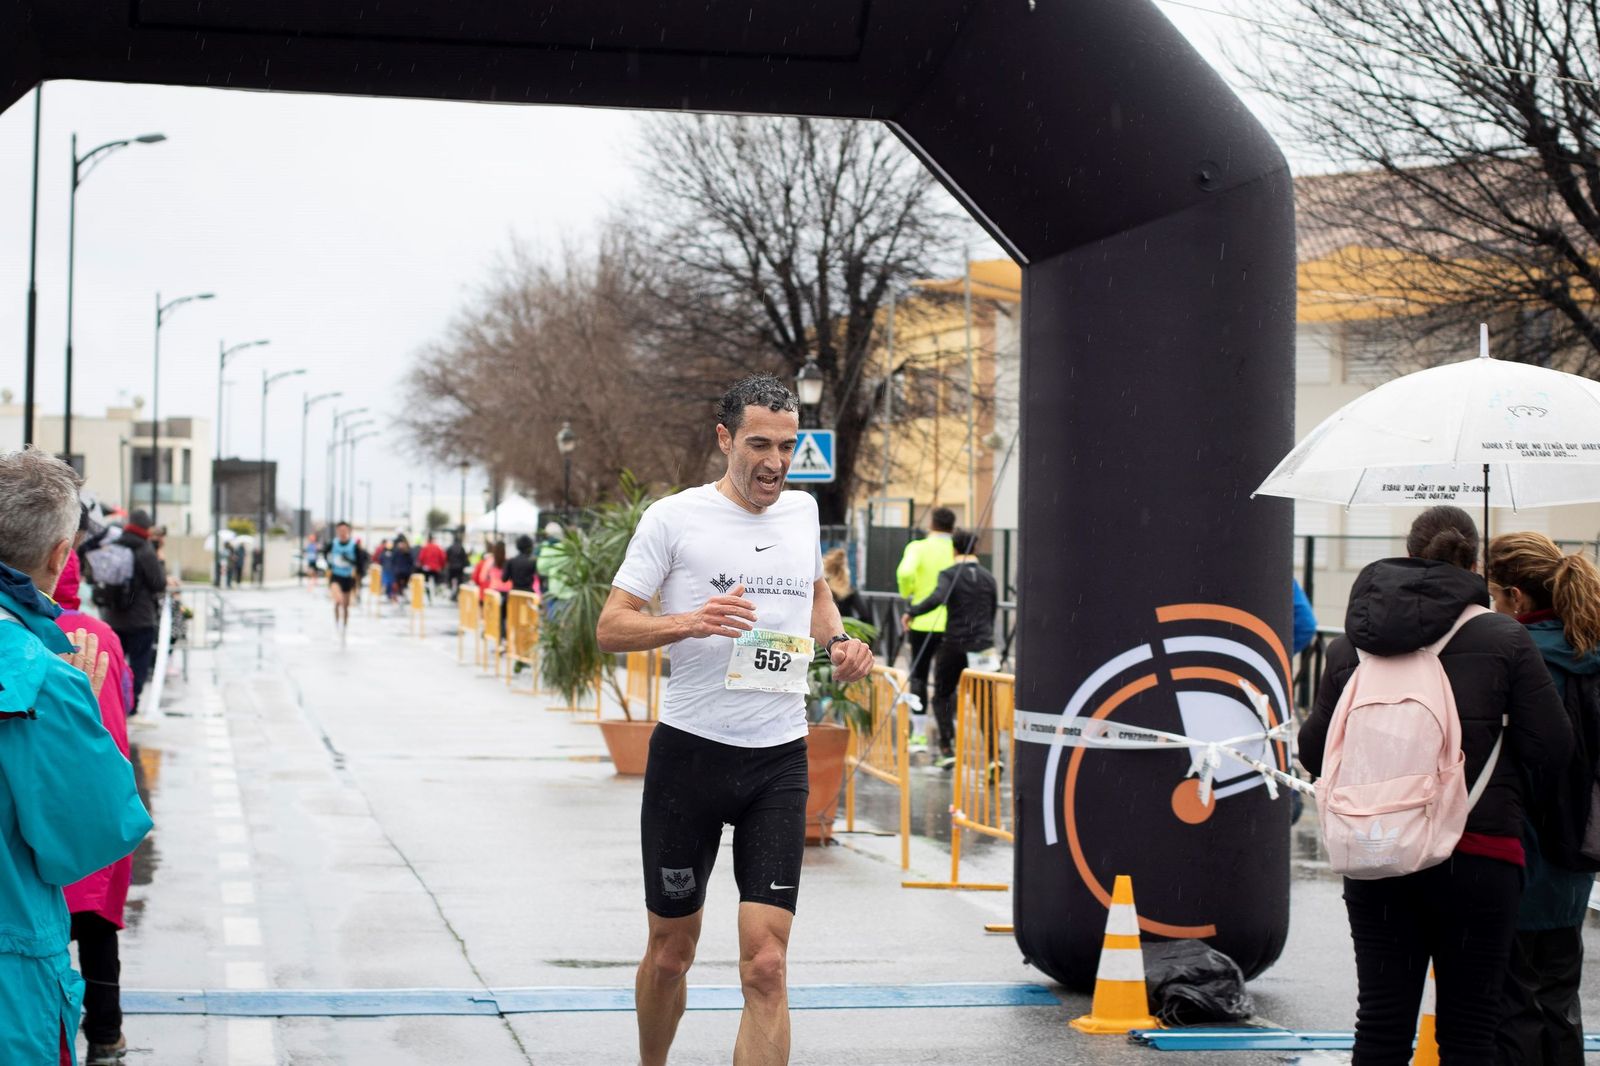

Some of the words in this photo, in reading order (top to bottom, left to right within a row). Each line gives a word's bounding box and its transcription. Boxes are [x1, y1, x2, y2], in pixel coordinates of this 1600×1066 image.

[739, 574, 809, 589] fundación
[757, 587, 781, 595] RURAL
[754, 647, 792, 672] 552
